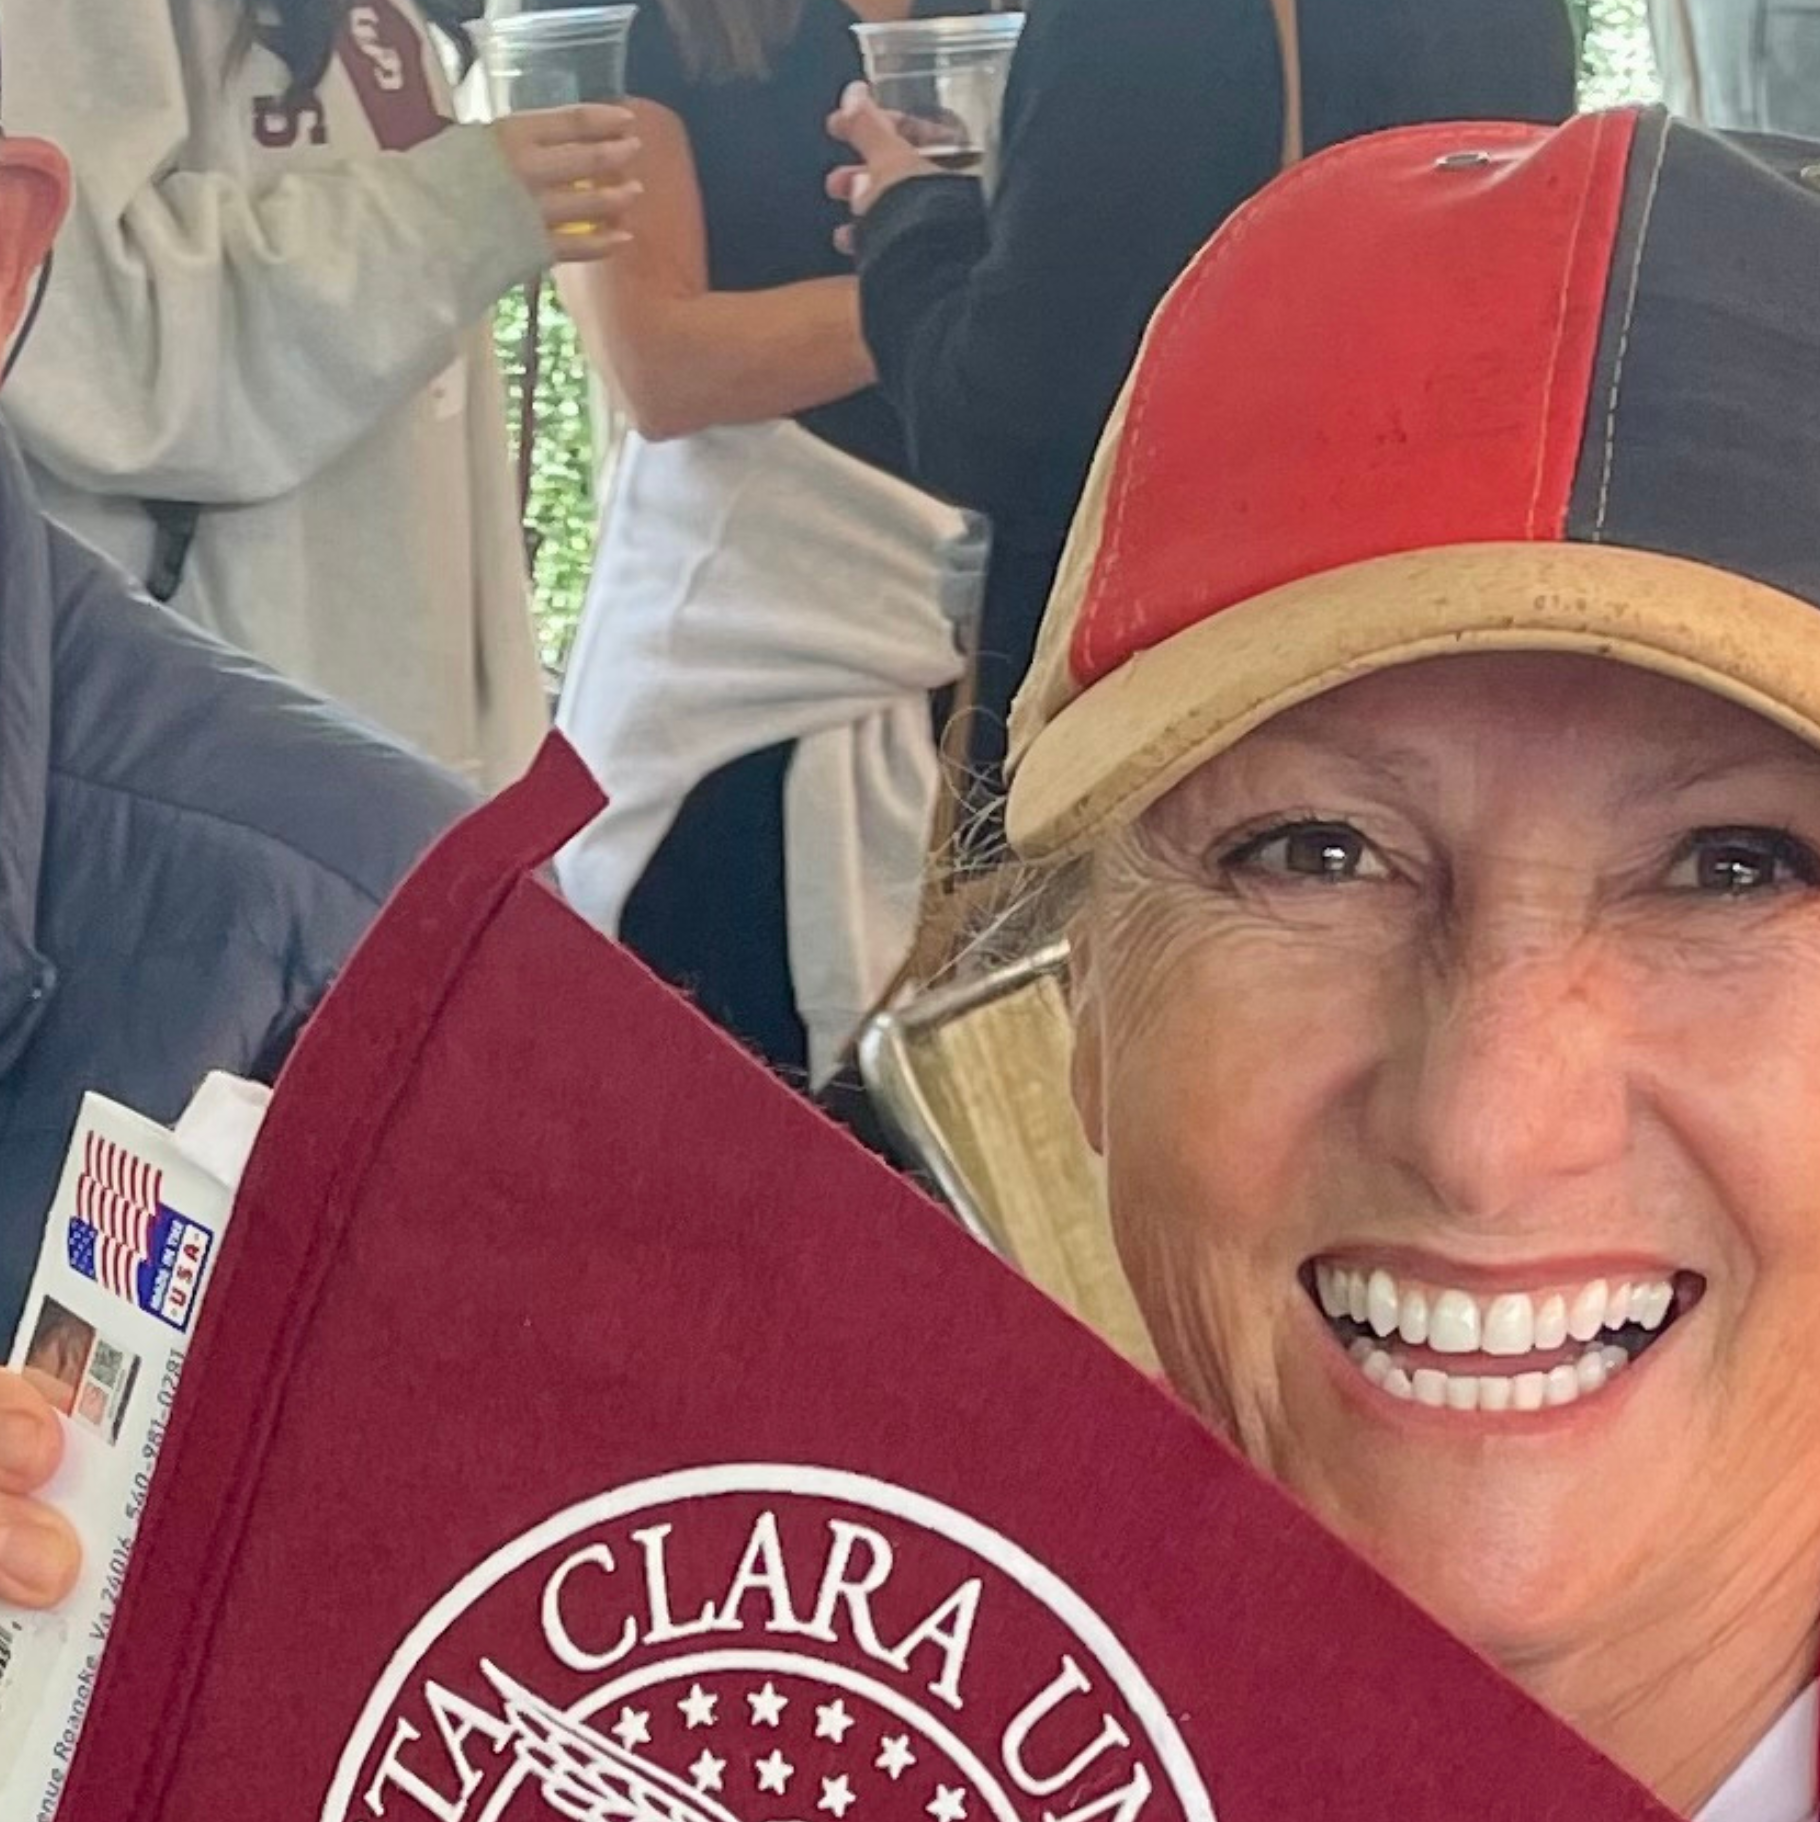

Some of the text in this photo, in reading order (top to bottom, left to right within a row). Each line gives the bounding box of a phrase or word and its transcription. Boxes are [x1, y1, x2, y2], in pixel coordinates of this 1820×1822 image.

[168, 1242, 202, 1307] USA
[541, 1501, 981, 1709] CLARA
[53, 1655, 98, 1761] Roanoke
